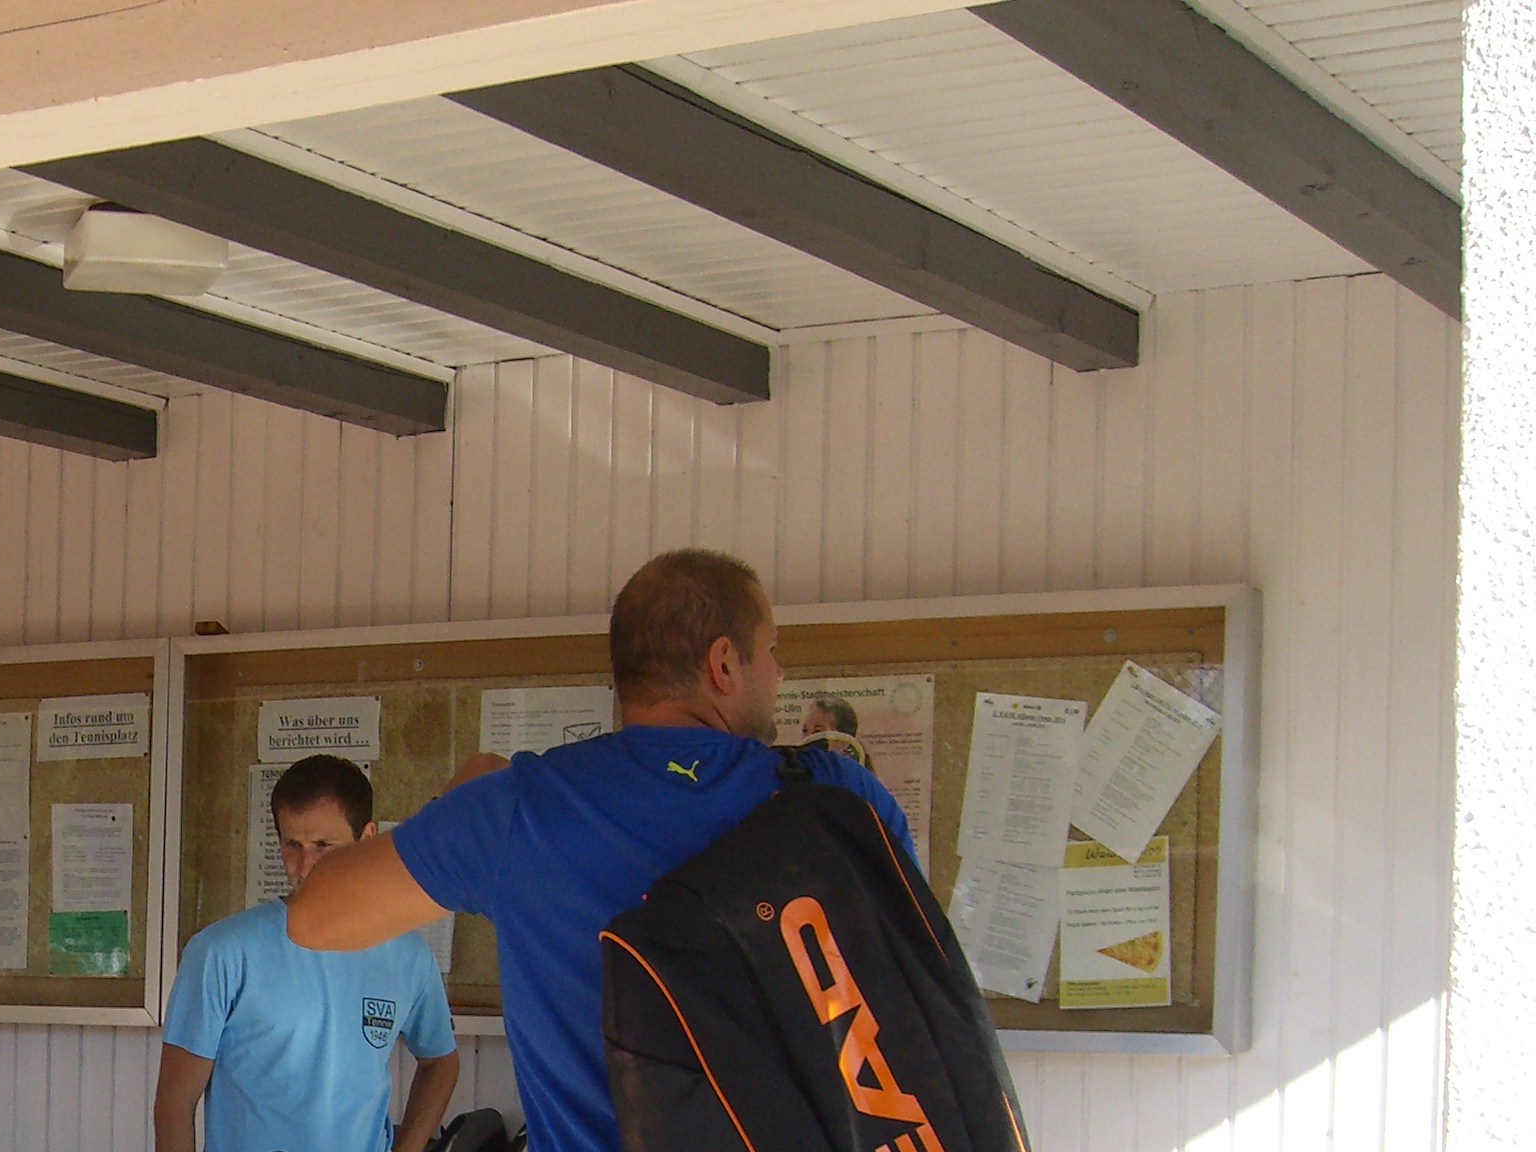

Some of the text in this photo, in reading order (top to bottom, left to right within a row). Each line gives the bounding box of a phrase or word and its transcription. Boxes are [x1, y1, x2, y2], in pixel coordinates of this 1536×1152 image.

[777, 688, 885, 700] ennis-Stadtmeisterschaft
[775, 703, 802, 714] u-Ulm
[54, 711, 134, 726] Infos rund um
[279, 714, 360, 727] Was über uns
[49, 729, 138, 744] den Tennisplatz
[269, 734, 320, 747] berichtet
[324, 732, 351, 745] wird
[261, 770, 282, 779] TENN
[367, 1001, 393, 1018] SVA
